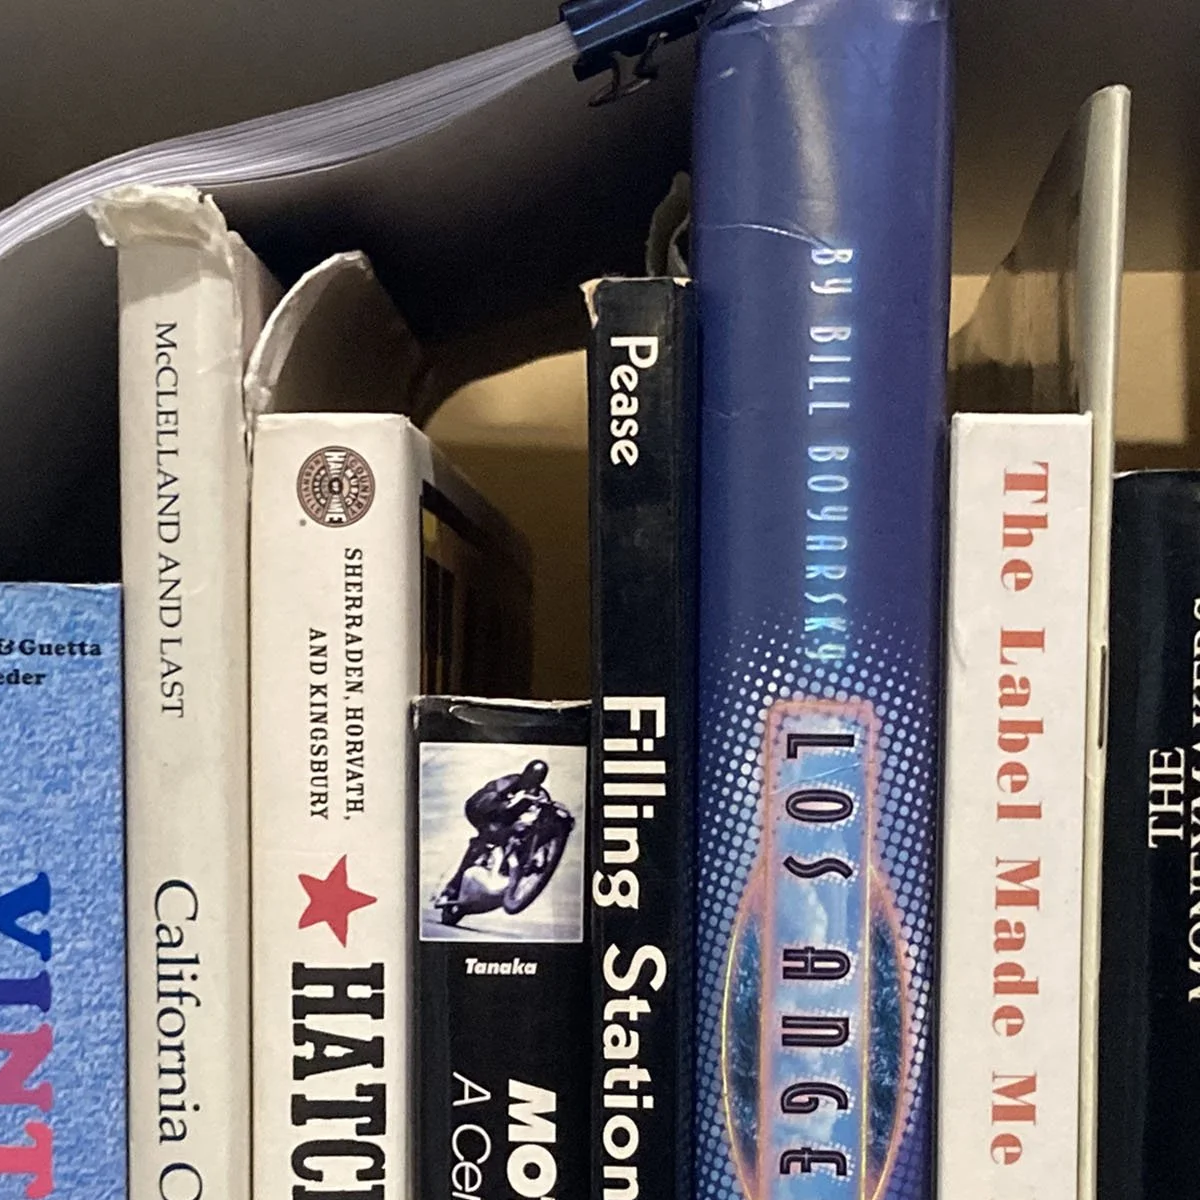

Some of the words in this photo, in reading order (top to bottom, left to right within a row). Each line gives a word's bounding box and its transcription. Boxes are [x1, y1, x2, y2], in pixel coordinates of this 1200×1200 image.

[155, 322, 181, 544] McCLELLAND
[610, 335, 659, 466] Pease
[808, 325, 852, 416] BILL
[158, 551, 182, 629] AND
[804, 445, 850, 667] BOYARSKY
[1000, 461, 1049, 592] The
[19, 638, 101, 656] Guetta
[159, 637, 185, 719] LAST
[309, 627, 328, 676] AND
[343, 547, 364, 701] SHERRADEN,
[309, 683, 329, 820] KINGSBURY
[343, 706, 365, 821] HORVATH,
[996, 628, 1046, 821] Label
[593, 696, 667, 910] Filling
[784, 733, 854, 879] LOS
[1148, 747, 1185, 849] THE
[153, 879, 202, 1144] California
[465, 957, 538, 975] Tanaka
[991, 856, 1041, 1037] Made
[452, 1071, 492, 1107] A
[990, 1071, 1038, 1166] Me
